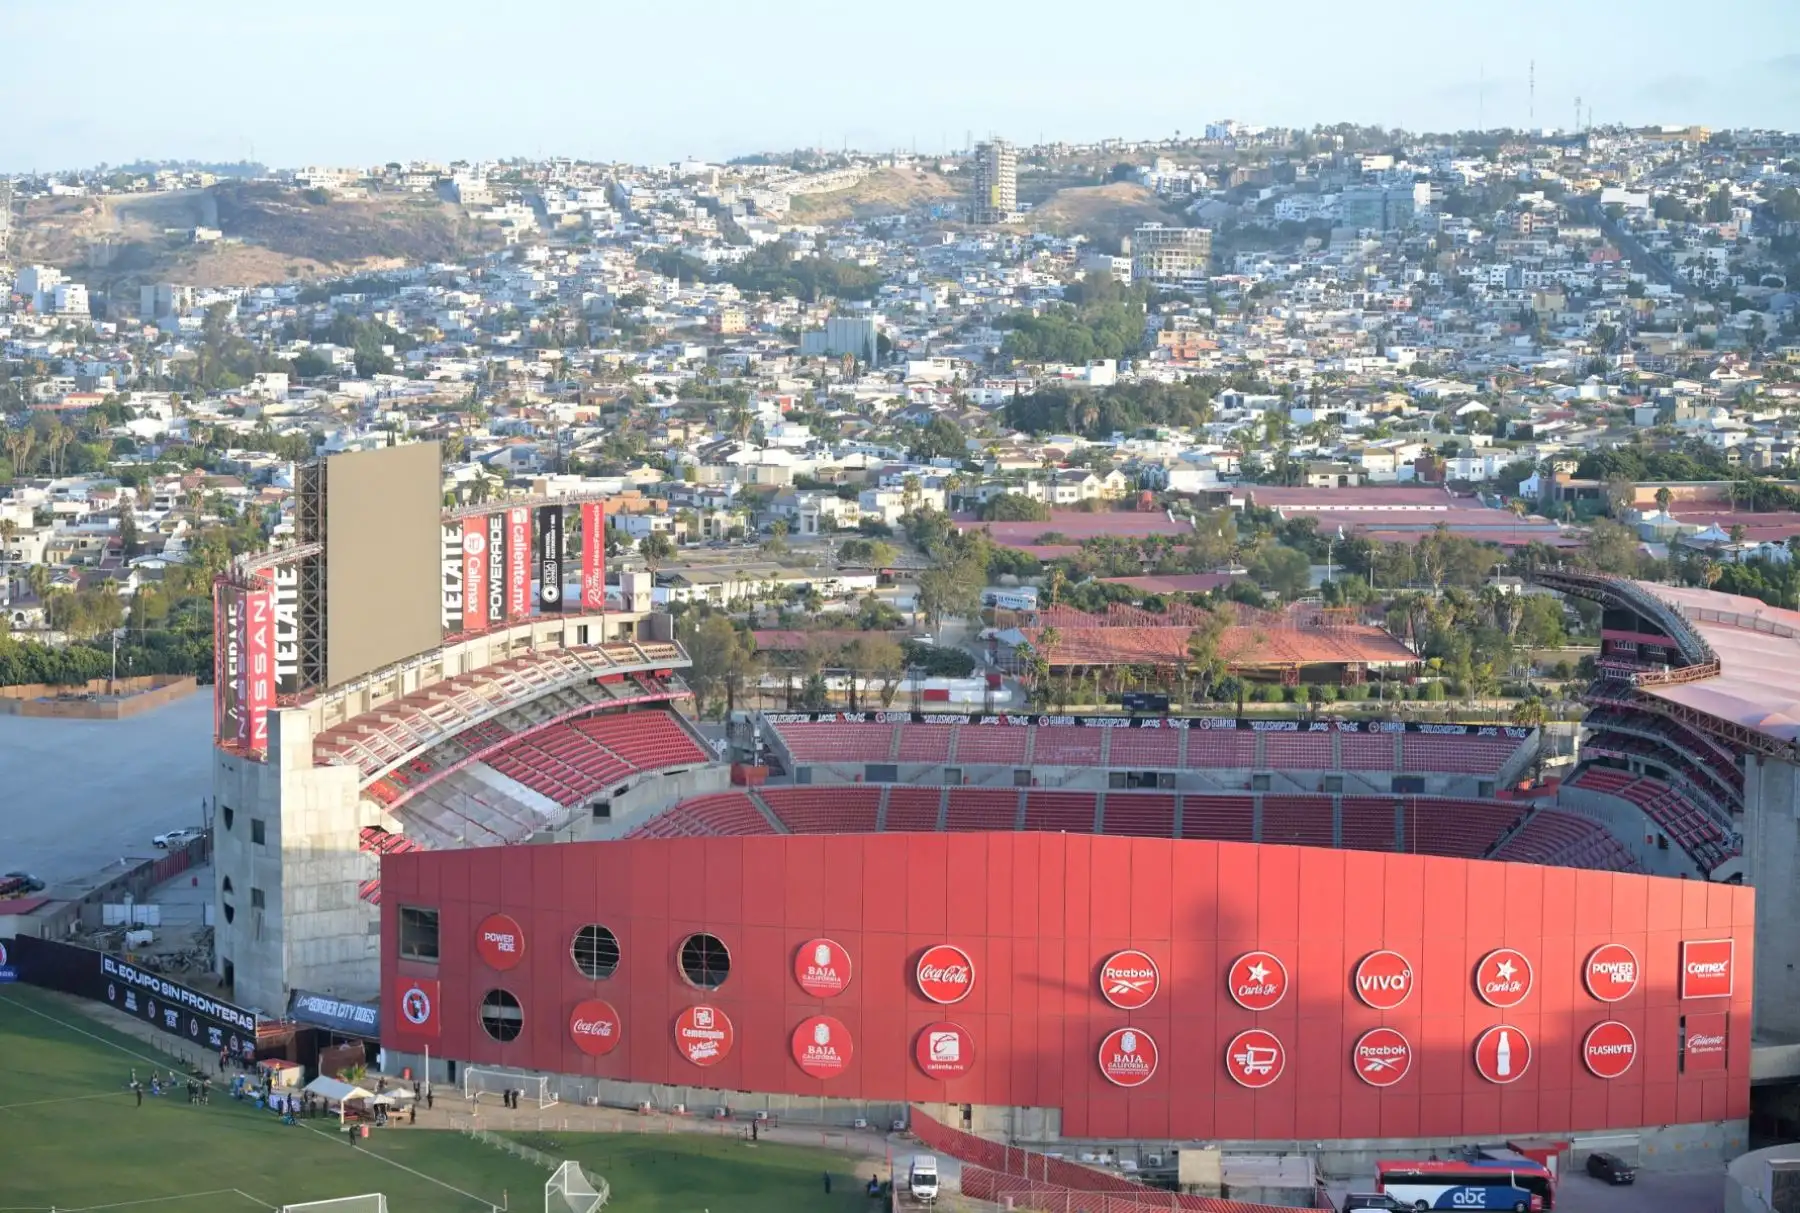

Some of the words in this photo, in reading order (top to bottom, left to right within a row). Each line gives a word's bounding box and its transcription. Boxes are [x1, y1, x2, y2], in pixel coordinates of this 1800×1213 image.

[512, 525, 528, 613] caliente.mx
[441, 524, 463, 629] TECATE
[467, 556, 482, 613] Calimax
[269, 565, 298, 686] TECATE
[237, 599, 246, 739] NISSAN
[254, 600, 268, 740] NISSAN
[484, 932, 514, 943] POWER
[807, 965, 837, 978] BAJA
[920, 964, 970, 984] Coca-Cola
[1106, 967, 1155, 978] Reebok
[1592, 962, 1634, 974] POWER
[1687, 960, 1729, 974] Comex
[802, 974, 842, 983] CALIFORNIA
[1238, 984, 1263, 997] Carl's
[1485, 981, 1510, 993] Carl's
[104, 958, 118, 974] EL
[119, 964, 160, 992] EQUIPO
[161, 982, 180, 1001] SIN
[181, 991, 254, 1031] FRONTERAS
[308, 996, 339, 1016] BORDER
[337, 1003, 356, 1020] CITY
[354, 1005, 377, 1024] DOGS
[573, 1018, 613, 1037] Coca-Cola
[1687, 1033, 1725, 1049] Caliente
[807, 1045, 836, 1056] BAJA
[1359, 1044, 1406, 1057] Reebok
[1588, 1044, 1633, 1056] FLASHLYTE
[802, 1053, 842, 1062] CALIFORNIA
[1113, 1053, 1143, 1063] BAJA
[1453, 1187, 1486, 1204] abc
